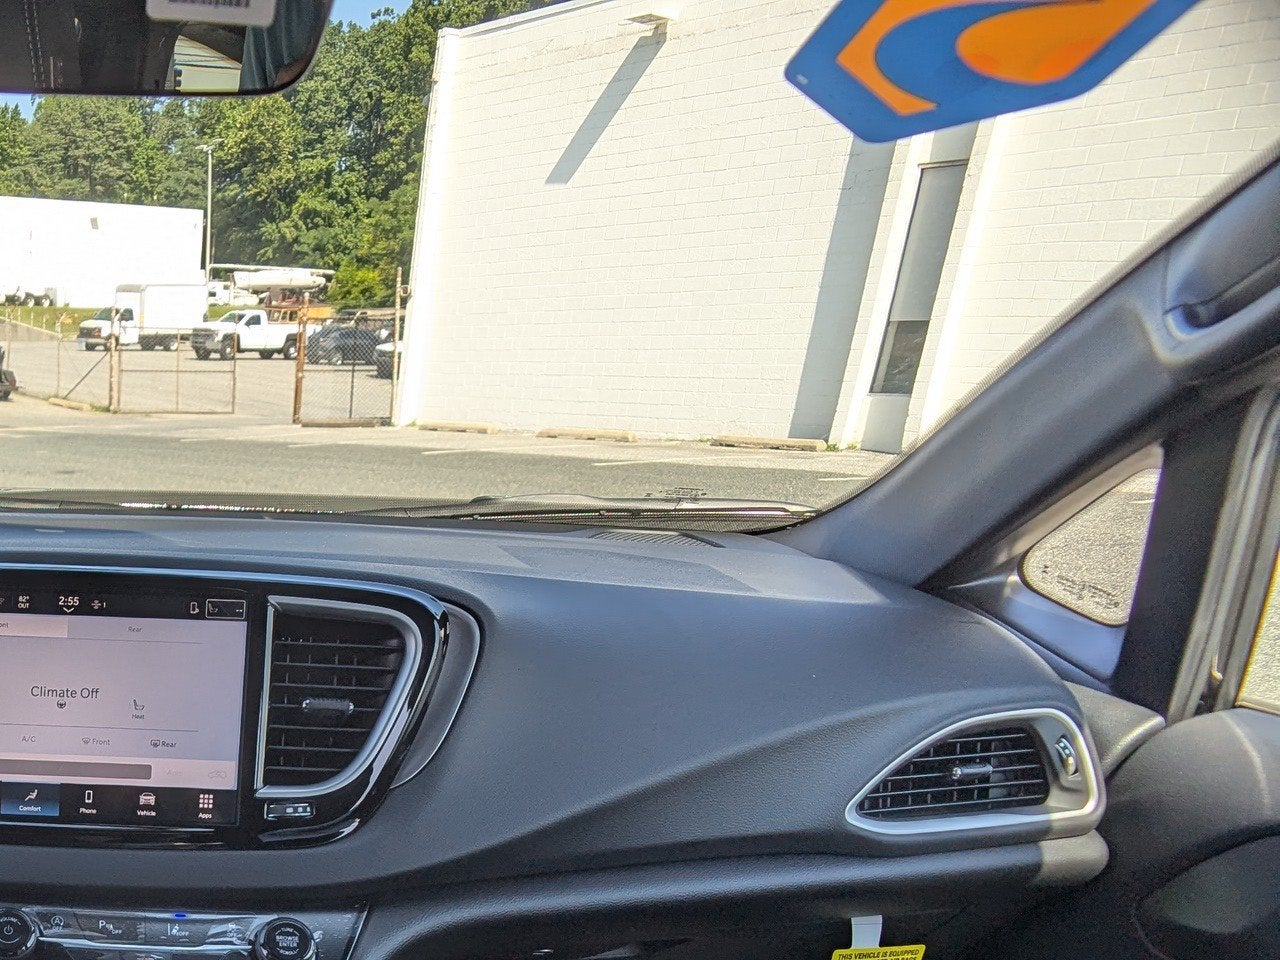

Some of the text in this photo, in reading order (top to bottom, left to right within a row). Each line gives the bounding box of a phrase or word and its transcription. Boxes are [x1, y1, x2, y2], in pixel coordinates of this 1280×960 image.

[58, 596, 80, 606] 2:55
[30, 685, 100, 699] Climate Off
[21, 735, 36, 743] A/C
[92, 737, 111, 746] Front
[161, 740, 177, 748] Rear
[19, 804, 42, 813] Comfort
[79, 806, 98, 815] Phone
[136, 809, 157, 817] Vehicle
[198, 812, 213, 820] Apps
[854, 952, 881, 960] VEHICLE
[889, 949, 920, 957] EQUIPPED
